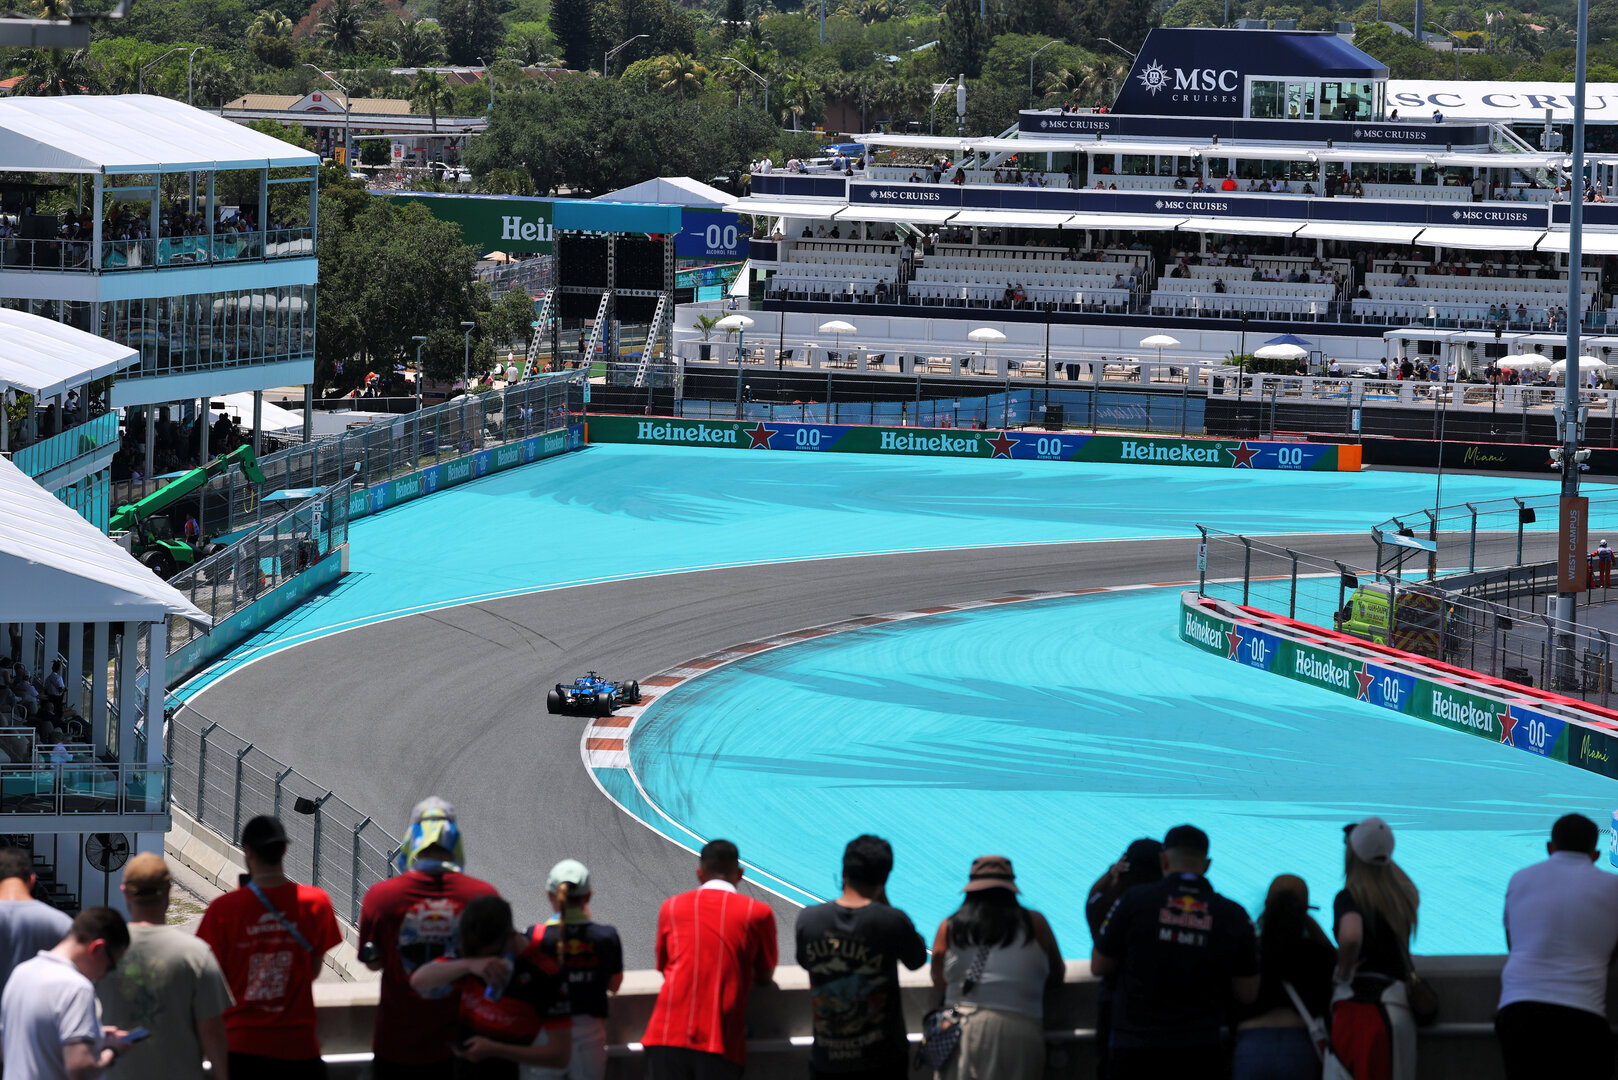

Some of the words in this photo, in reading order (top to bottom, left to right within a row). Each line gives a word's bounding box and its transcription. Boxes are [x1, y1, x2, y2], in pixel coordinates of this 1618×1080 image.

[1173, 68, 1238, 92] MSC
[1172, 94, 1237, 103] CRUISES
[1481, 93, 1618, 110] CRU
[1049, 120, 1068, 129] MSC
[1069, 120, 1110, 130] CRUISES
[1363, 129, 1383, 138] MSC
[1384, 130, 1427, 140] CRUISES
[879, 190, 898, 199] MSC
[899, 191, 940, 201] CRUISES
[1164, 200, 1185, 209] MSC
[1185, 201, 1228, 211] CRUISES
[1462, 211, 1483, 220] MSC
[1484, 211, 1528, 221] CRUISES
[706, 224, 738, 250] 0.0
[637, 421, 737, 443] Heineken
[796, 428, 820, 446] 0.0
[880, 431, 979, 453] Heineken
[1037, 437, 1061, 456] 0.0
[1120, 441, 1220, 463] Heineken
[1278, 447, 1302, 465] 0.0
[1463, 446, 1507, 465] Miami
[447, 463, 469, 481] Heineken
[395, 479, 419, 500] Heineken
[1569, 509, 1577, 551] CAMPUS
[1568, 553, 1576, 581] WEST
[1185, 612, 1222, 649] Heineken
[1251, 637, 1265, 663] 0.0
[1295, 649, 1351, 689] Heineken
[1383, 676, 1399, 703] 0.0
[1432, 690, 1493, 733] Heineken
[1528, 719, 1546, 748] 0.0
[1580, 734, 1610, 765] Miami
[806, 936, 884, 970] SUZUKA
